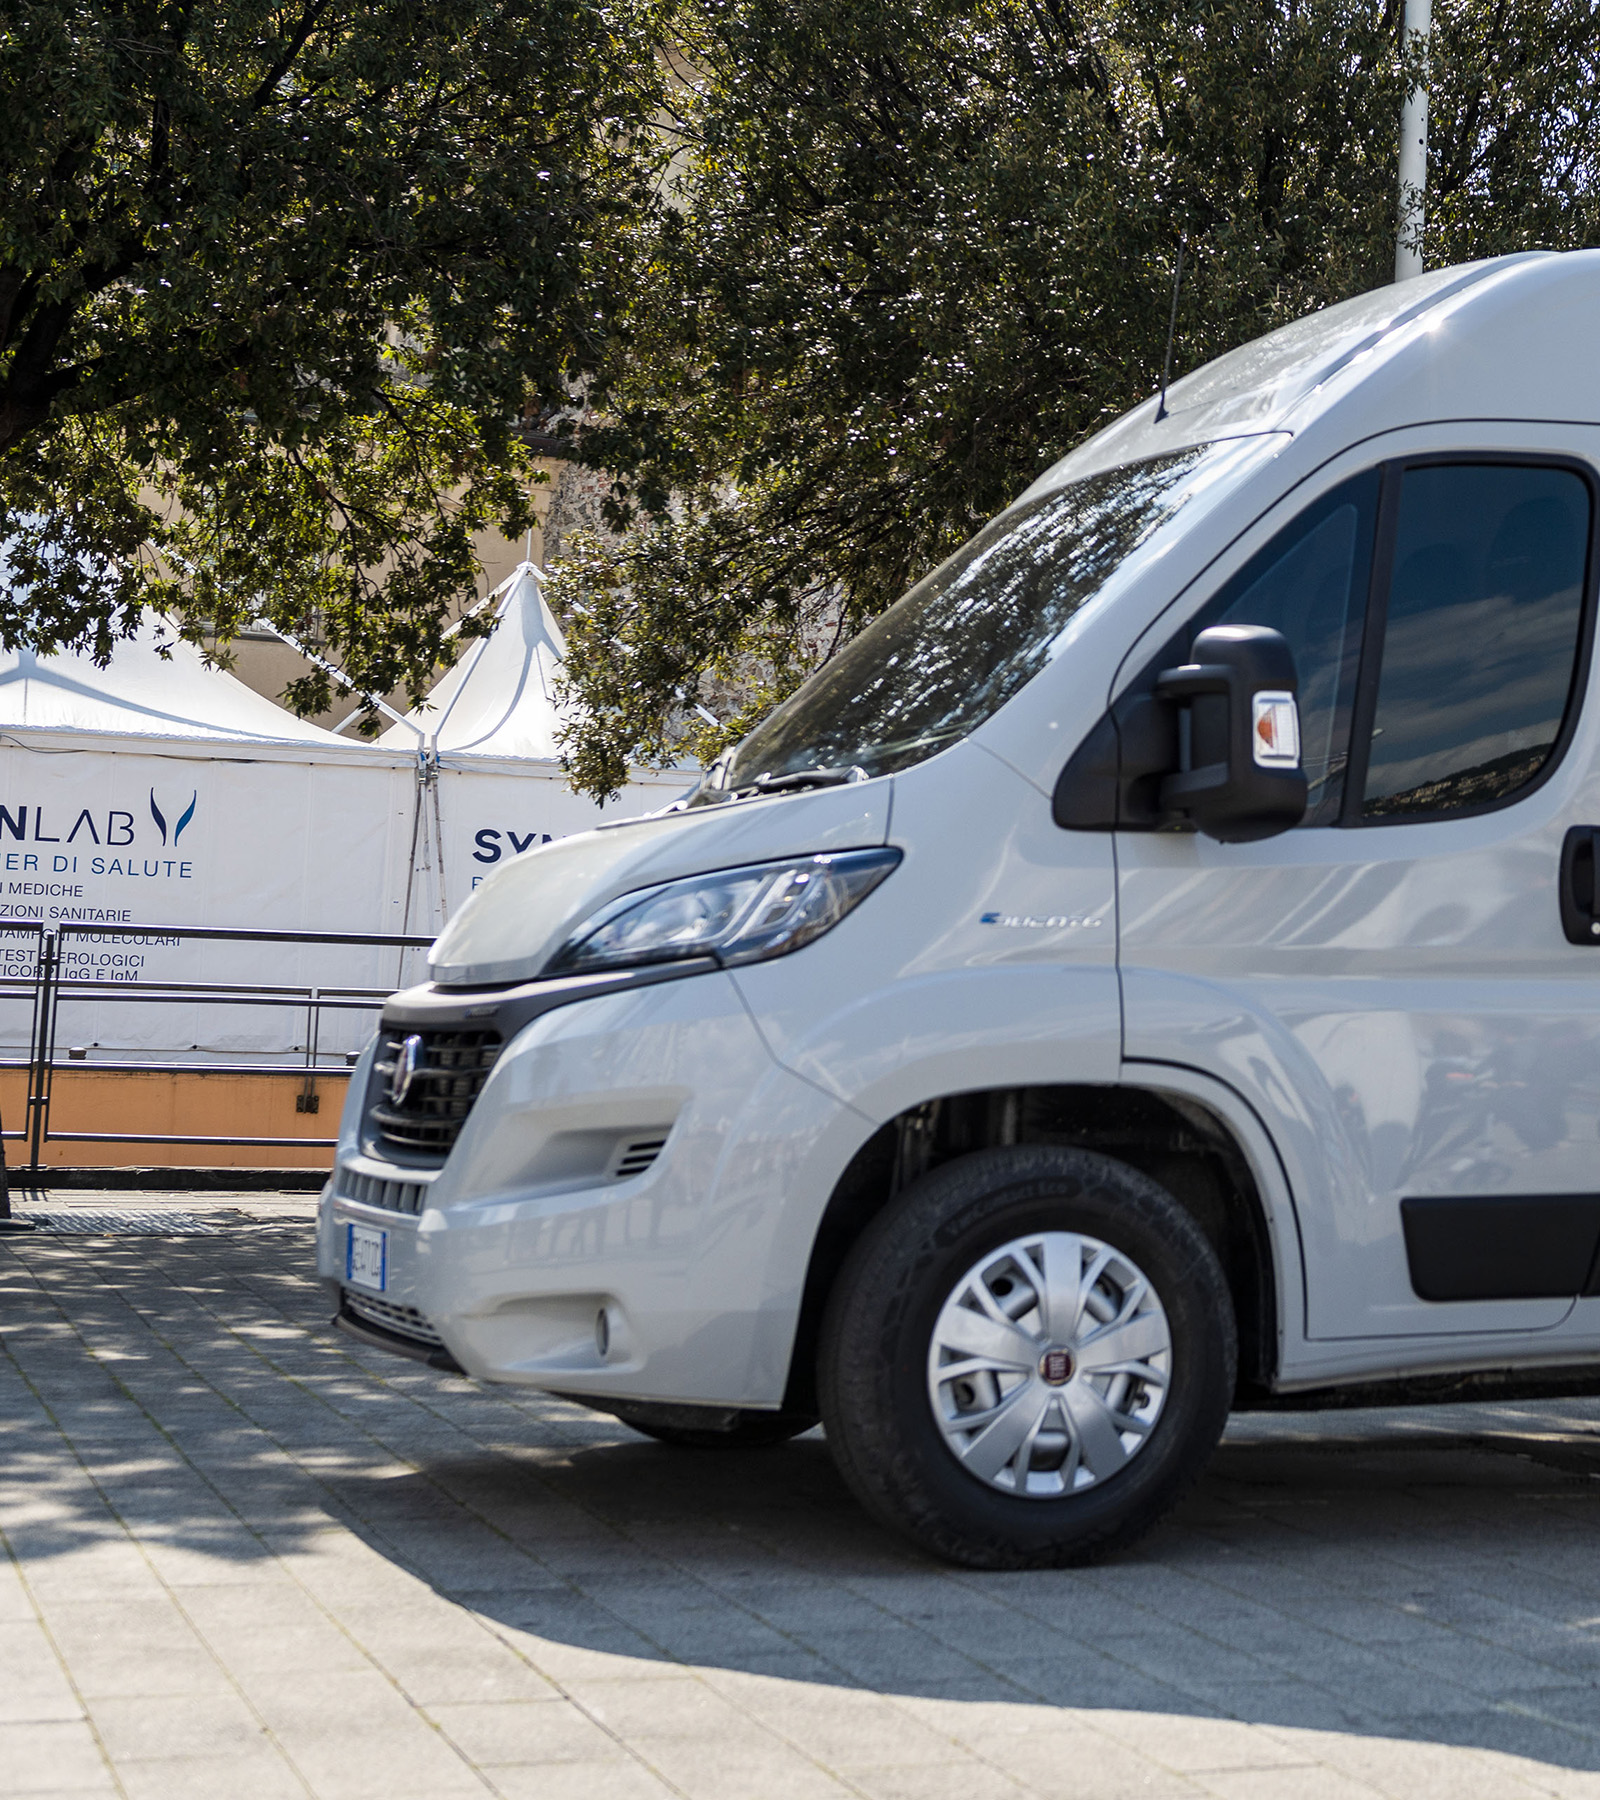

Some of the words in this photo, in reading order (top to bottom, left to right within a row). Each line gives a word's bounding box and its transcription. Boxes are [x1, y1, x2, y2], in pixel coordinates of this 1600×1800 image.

[0, 853, 38, 872] ER
[53, 855, 77, 873] DI
[91, 857, 192, 879] SALUTE
[9, 882, 84, 898] MEDICHE
[0, 904, 43, 918] ZIONI
[49, 906, 131, 922] SANITARIE
